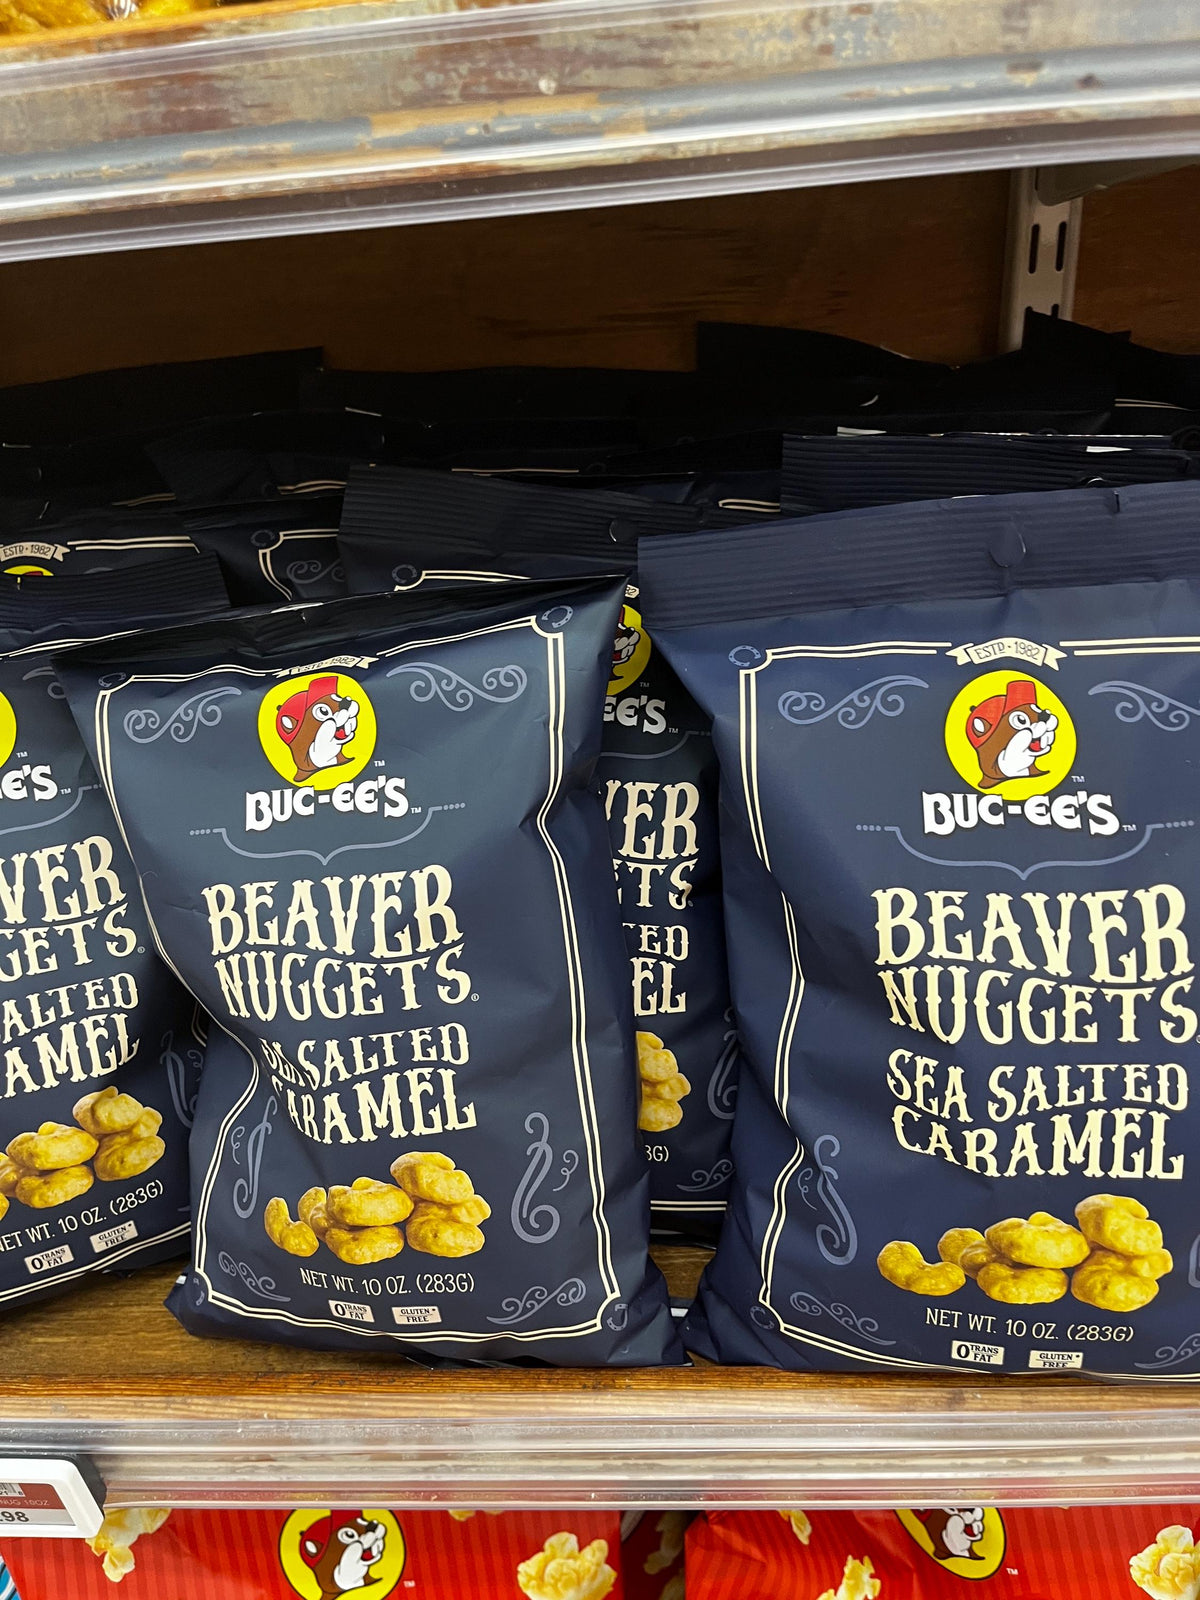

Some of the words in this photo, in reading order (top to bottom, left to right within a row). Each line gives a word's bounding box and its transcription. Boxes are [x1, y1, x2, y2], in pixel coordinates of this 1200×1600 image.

[30, 544, 51, 557] 1982
[330, 656, 356, 666] 1982
[1014, 641, 1040, 661] 1982
[1071, 775, 1086, 783] TM
[245, 775, 409, 832] BUC-EE'S
[921, 790, 1120, 836] BUC-EE'S
[201, 864, 464, 959] BEAVER
[871, 883, 1195, 984] BEAVER
[214, 943, 473, 1022] NUGGETS
[0, 972, 139, 1045] ALTED
[877, 964, 1198, 1045] NUGGETS
[0, 1013, 140, 1099] AMEL
[297, 1022, 470, 1092] SALTED
[886, 1048, 974, 1123] SEA
[987, 1062, 1189, 1122] SALTED
[891, 1104, 1184, 1179] CARAMEL
[25, 1222, 56, 1244] WT.
[57, 1214, 79, 1234] 10
[80, 1206, 107, 1225] OZ.
[109, 1179, 164, 1216] (283G)
[40, 1247, 67, 1260] TRANS
[104, 1234, 127, 1248] FREE
[47, 1256, 65, 1268] FAT
[300, 1267, 328, 1289] NET
[331, 1273, 359, 1294] WT.
[361, 1278, 382, 1297] 10
[385, 1275, 412, 1295] OZ.
[416, 1272, 475, 1293] (283G)
[344, 1303, 368, 1313] TRANS
[350, 1311, 366, 1321] FAT
[406, 1315, 430, 1324] FREE
[925, 1307, 963, 1329] NET
[967, 1314, 997, 1335] WT.
[1006, 1319, 1027, 1338] 10
[1031, 1322, 1059, 1340] OZ.
[1066, 1323, 1134, 1343] (283G)
[970, 1343, 999, 1355] TRANS
[973, 1352, 994, 1364] FAT
